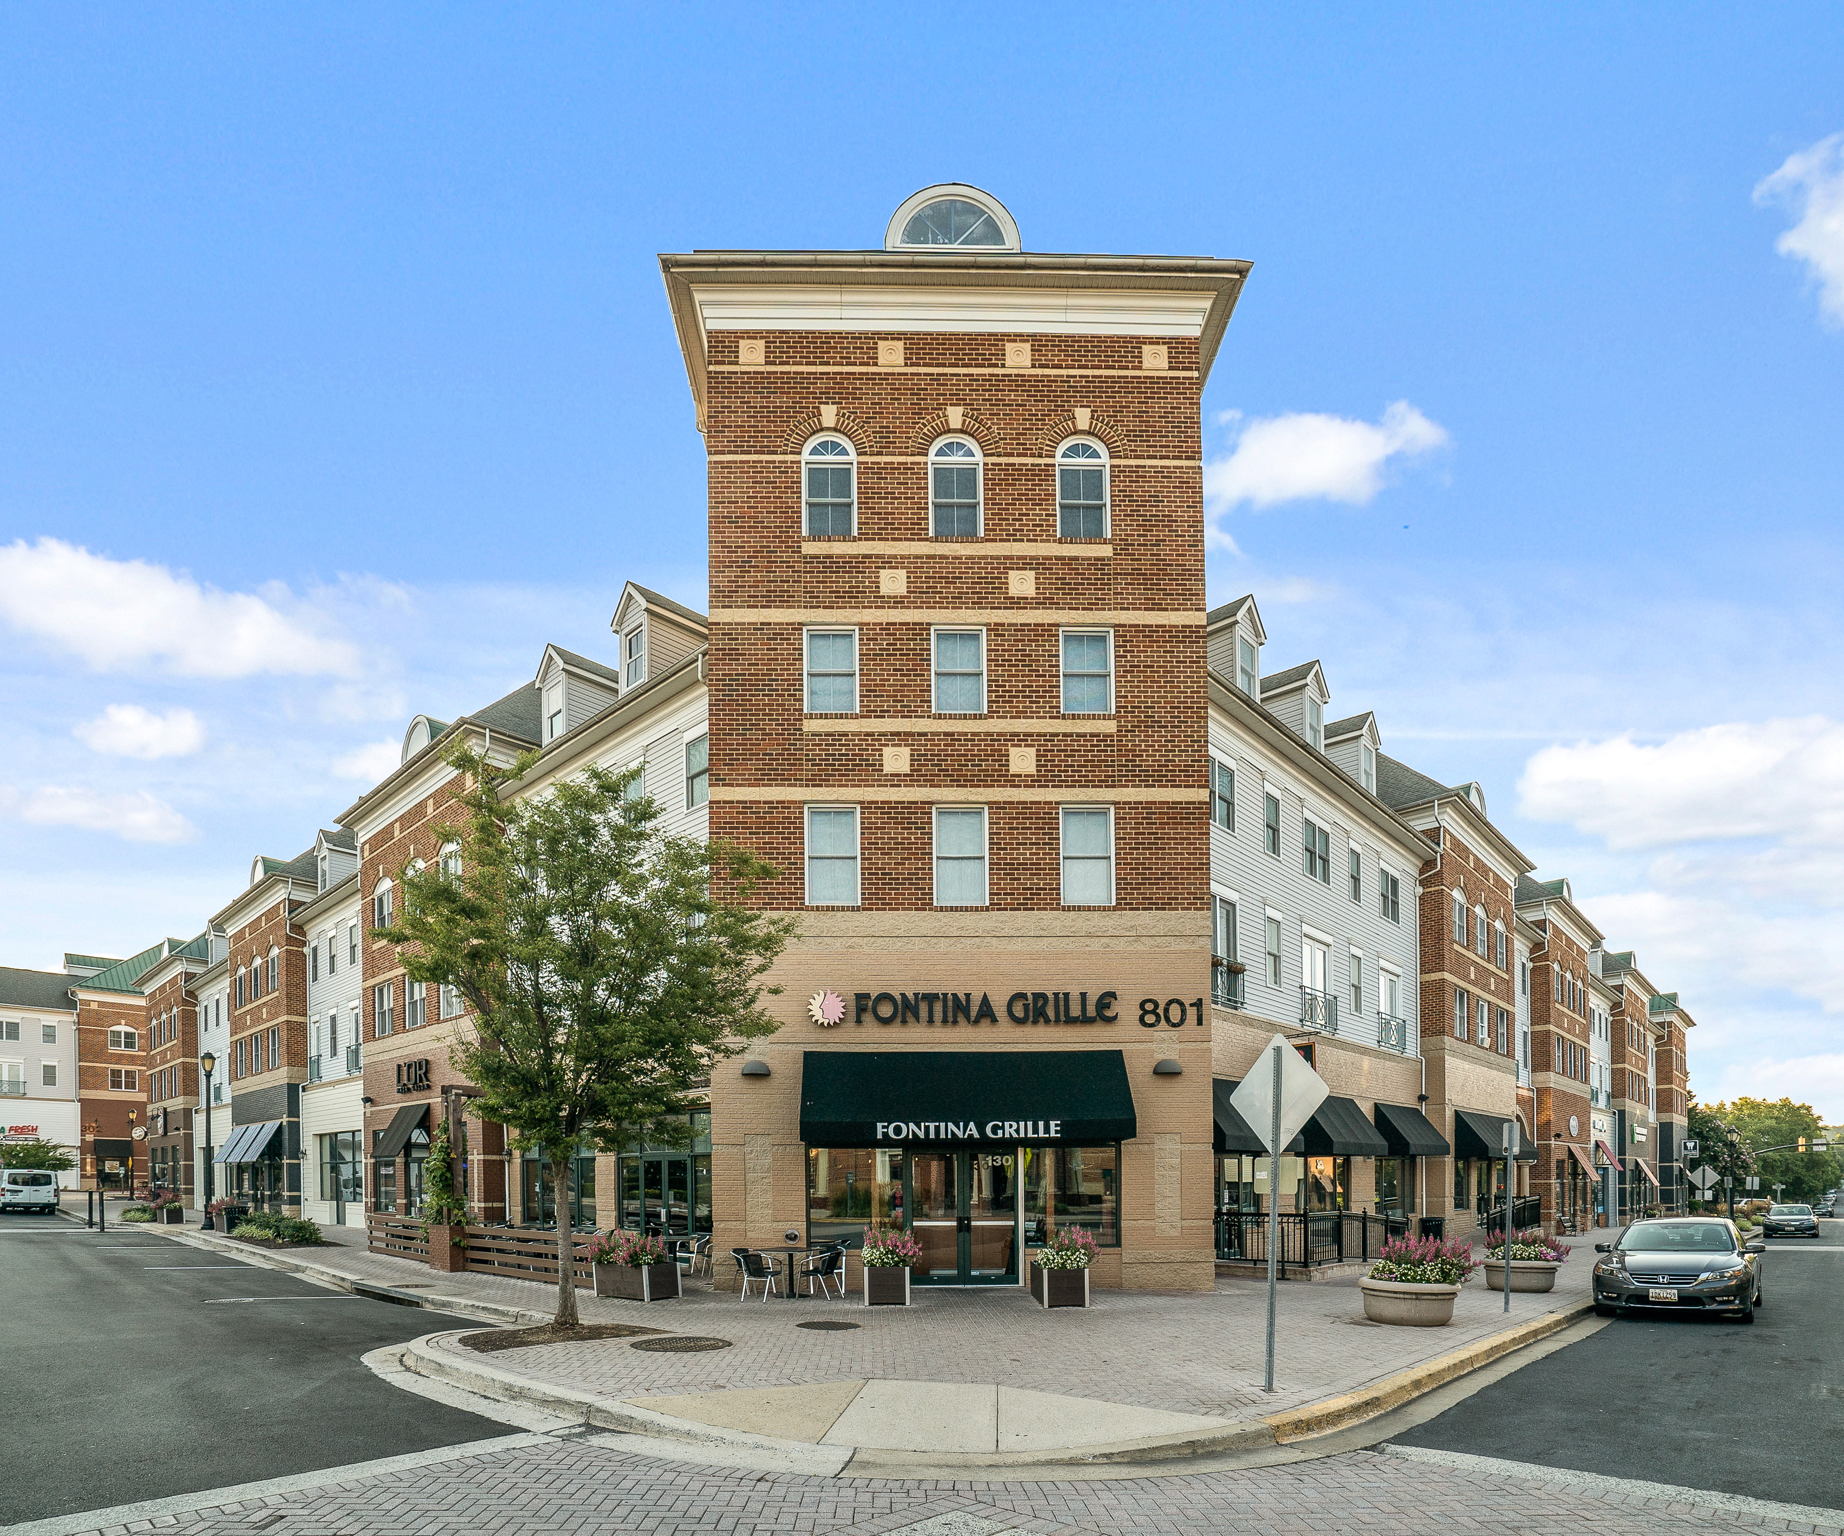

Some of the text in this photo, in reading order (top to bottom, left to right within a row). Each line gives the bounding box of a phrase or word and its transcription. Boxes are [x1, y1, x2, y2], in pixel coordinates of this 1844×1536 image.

[853, 991, 1119, 1024] FONTINA GRILLE
[1138, 998, 1204, 1028] 801
[8, 1124, 38, 1134] FRESH
[876, 1120, 1061, 1140] FONTINA GRILLE
[985, 1155, 1012, 1166] 130
